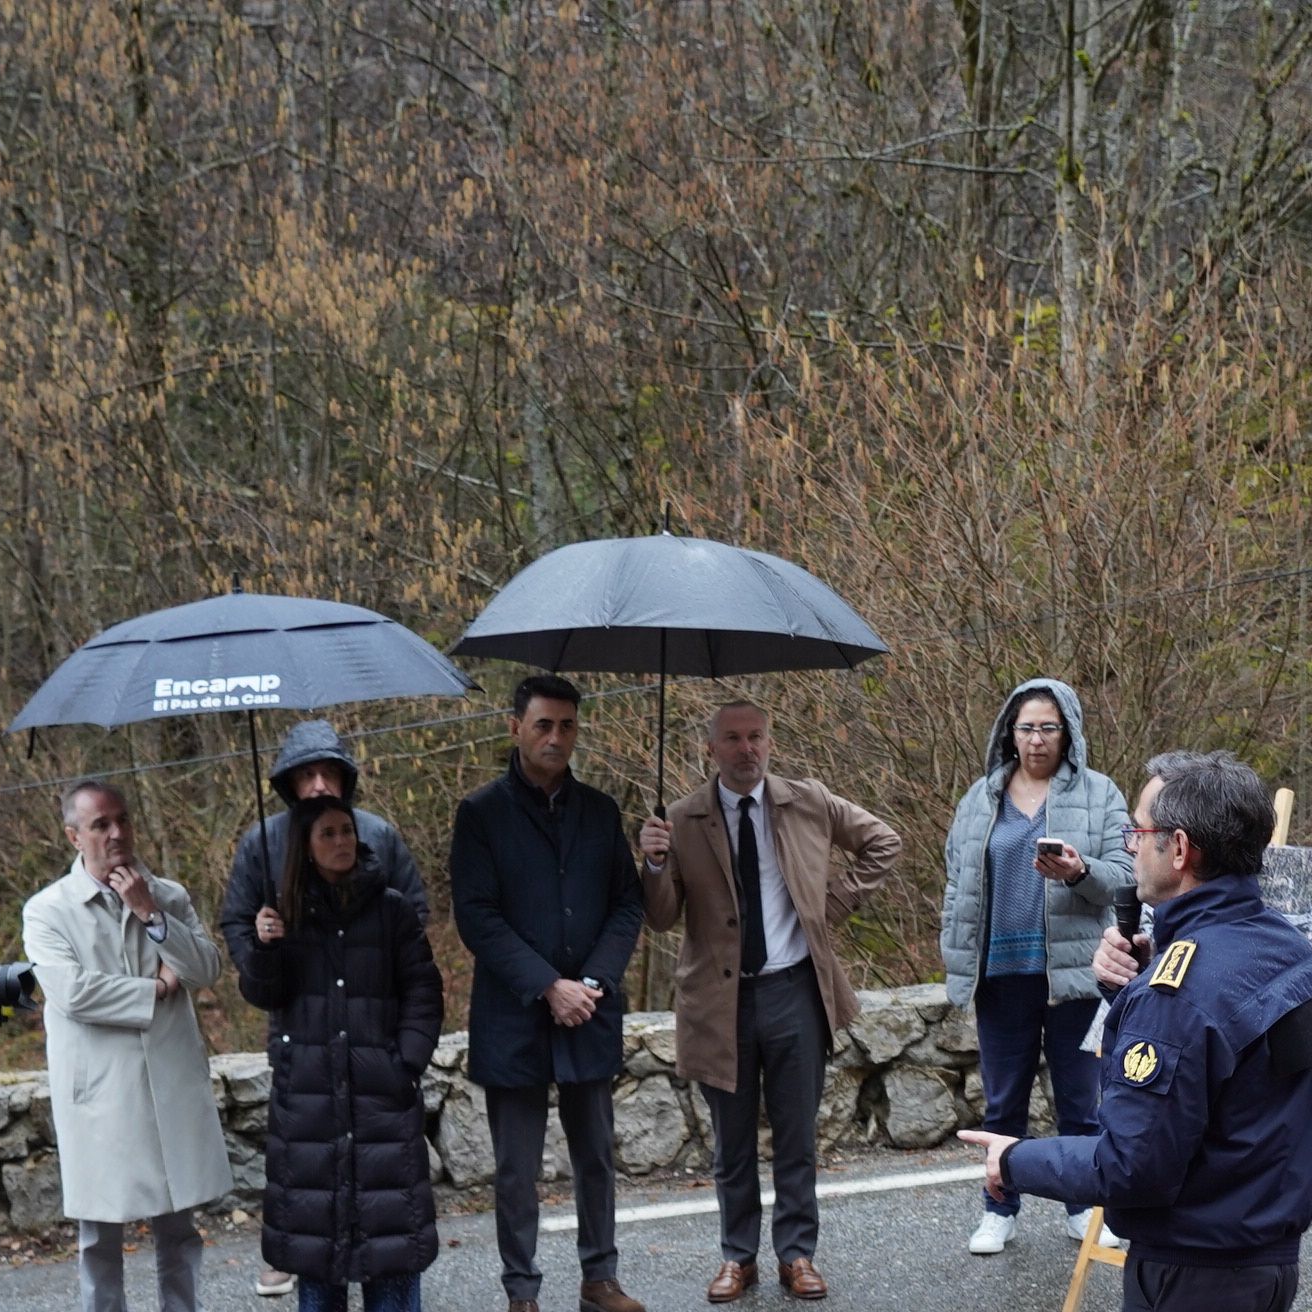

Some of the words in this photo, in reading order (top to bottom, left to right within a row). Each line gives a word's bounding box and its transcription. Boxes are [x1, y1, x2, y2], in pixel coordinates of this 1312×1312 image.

[155, 674, 281, 698] Encamp
[153, 699, 168, 712] El
[170, 698, 199, 710] Pas
[200, 696, 222, 708] de
[224, 694, 240, 706] la
[241, 693, 281, 705] Casa
